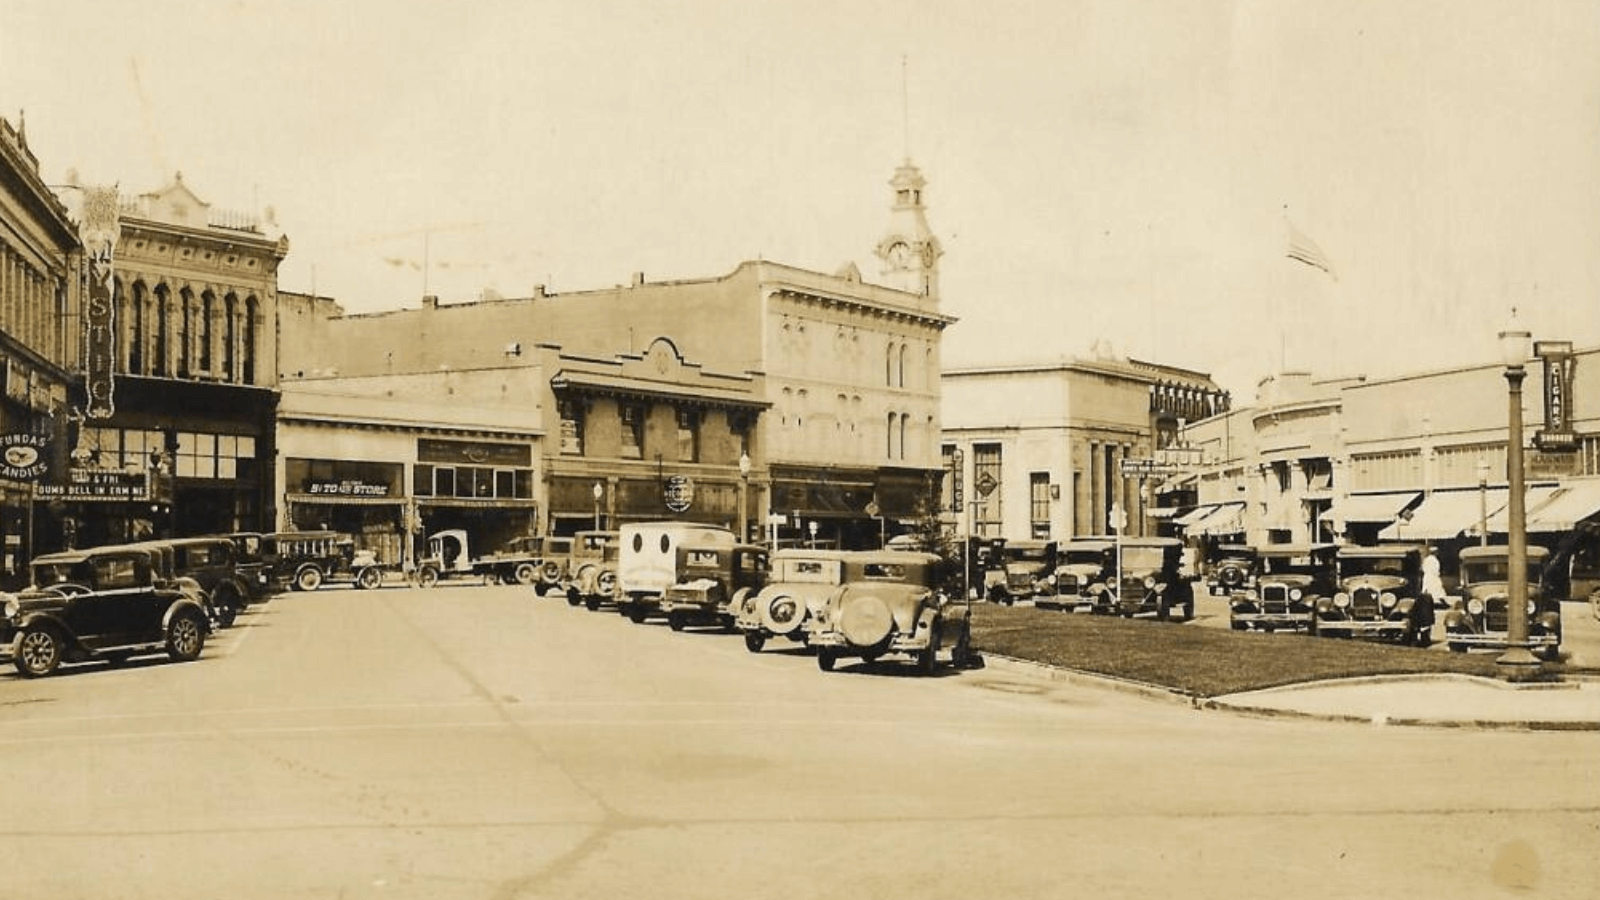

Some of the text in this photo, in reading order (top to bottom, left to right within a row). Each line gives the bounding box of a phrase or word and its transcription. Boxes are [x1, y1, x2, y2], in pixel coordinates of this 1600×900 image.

[91, 241, 111, 399] MYSTIC
[1552, 365, 1560, 424] CIGARS
[38, 485, 65, 495] DUMB
[110, 485, 144, 495] ERMNE
[353, 485, 387, 495] STORE
